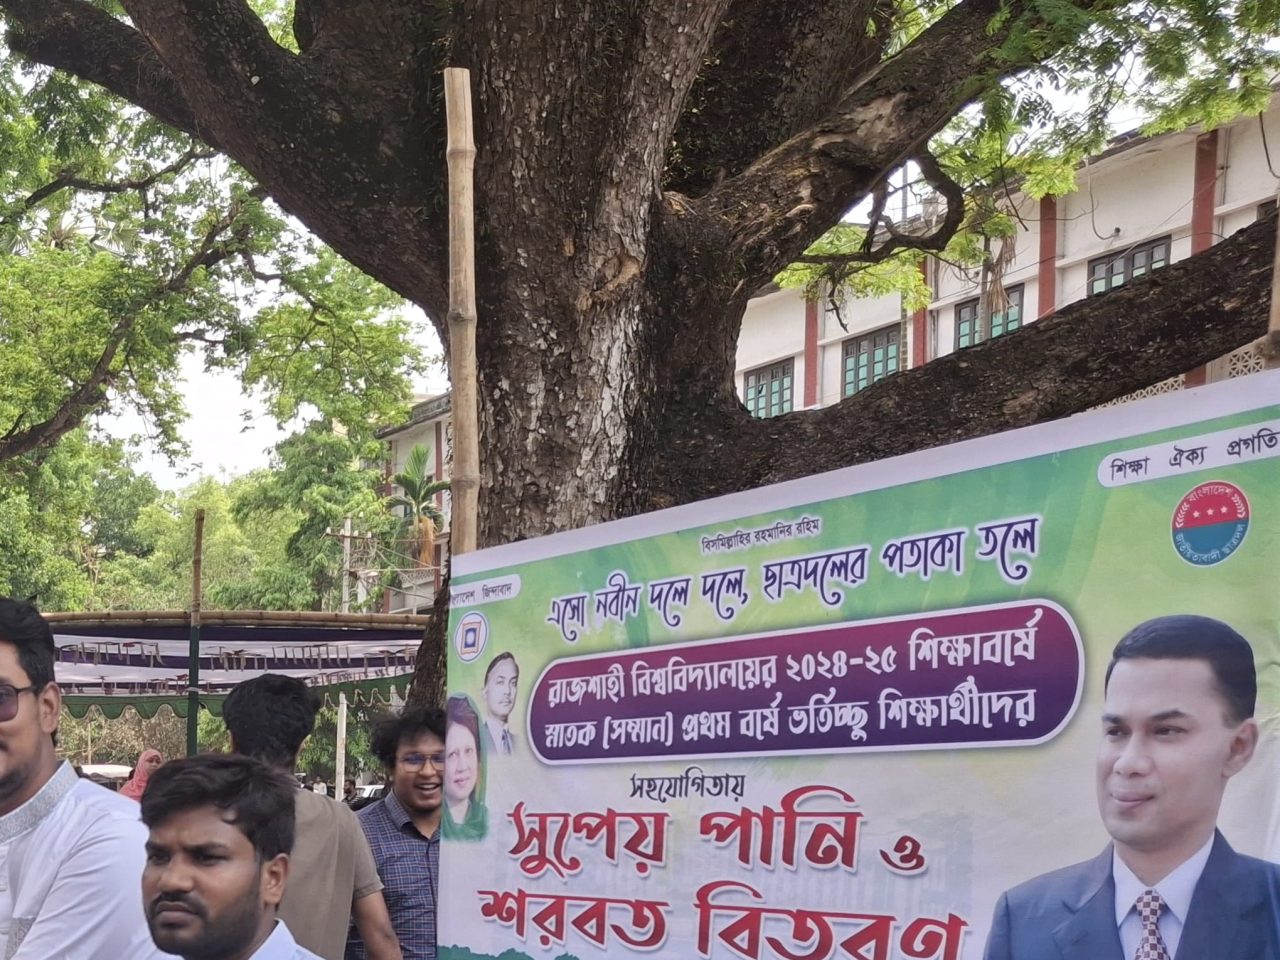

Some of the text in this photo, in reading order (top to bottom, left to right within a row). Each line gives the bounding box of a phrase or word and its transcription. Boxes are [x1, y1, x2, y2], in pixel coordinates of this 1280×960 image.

[1110, 428, 1280, 480] শিক্ষা ঐক্য প্রগতি
[701, 516, 820, 552] বিসমিল্লাহির রহমানির রহিম
[547, 518, 1039, 641] এসো নবীন দলে দলে, ছাত্রদলের পতাকা তলে
[548, 608, 1043, 708] রাজশাহী বিশ্ববিদ্যালয়ের ২০২৪-২৫ শিক্ষাবর্ষে
[544, 675, 1037, 750] স্নাতক (সম্মান) প্রথম বর্ষে ভর্তিচ্ছু শিক্ষার্থীদের
[630, 766, 746, 803] সহযোগিতায়
[507, 784, 926, 880] সুপেয় পানি ও
[477, 887, 670, 951] শরবত
